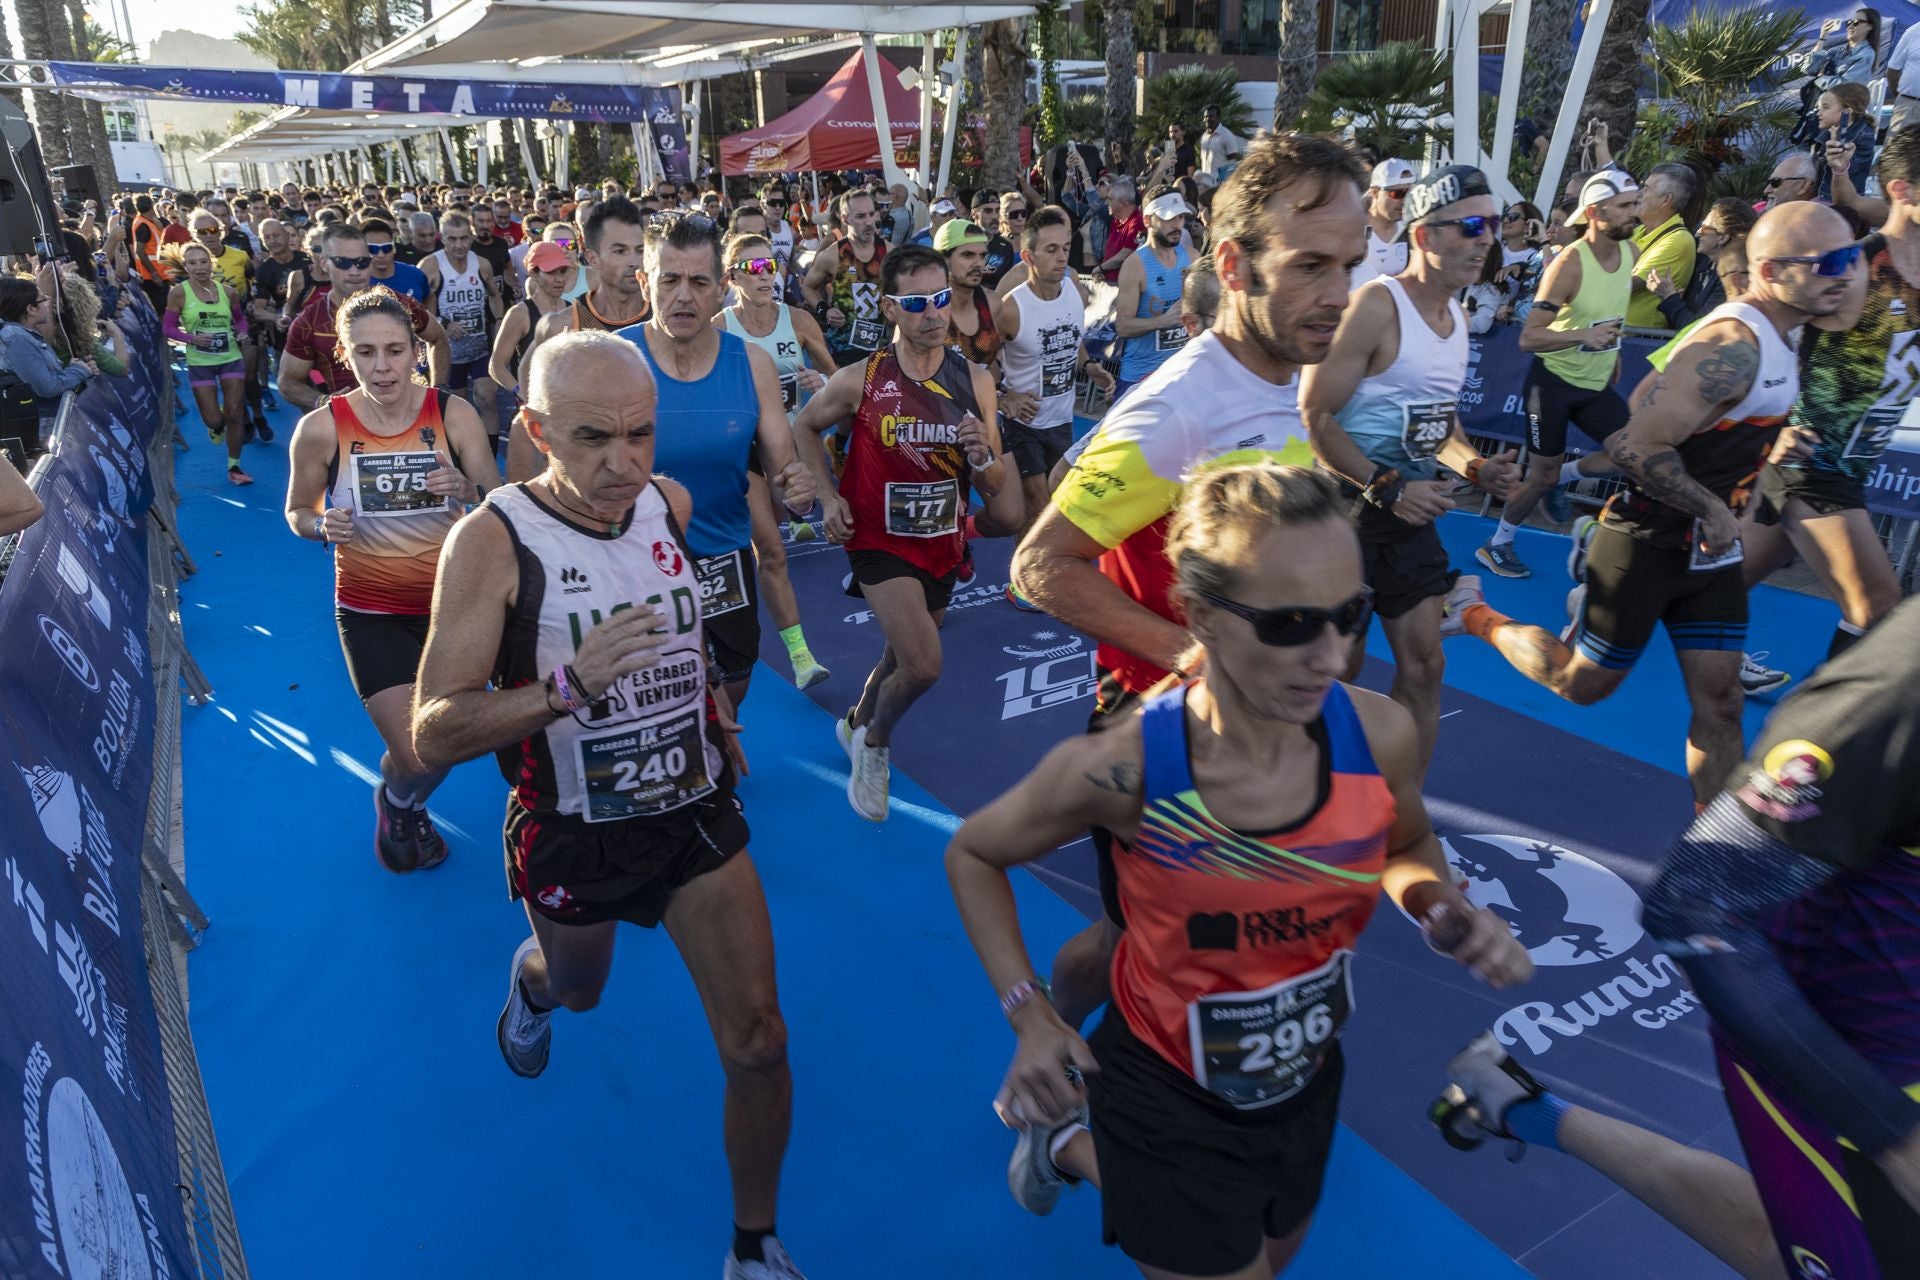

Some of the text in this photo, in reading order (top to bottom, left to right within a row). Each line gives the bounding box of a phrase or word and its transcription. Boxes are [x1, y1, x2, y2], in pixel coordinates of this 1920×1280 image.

[285, 78, 477, 114] META
[1413, 420, 1449, 441] 288
[393, 456, 407, 467] IX
[375, 472, 427, 493] 675
[904, 498, 947, 518] 177
[93, 668, 131, 773] BOLUDA
[592, 716, 695, 752] CARRERA IX SOLIDARIA
[612, 746, 687, 792] 240
[633, 783, 676, 800] EDUARDO
[1237, 1002, 1334, 1073] 296
[23, 1040, 64, 1277] AMARRADORES
